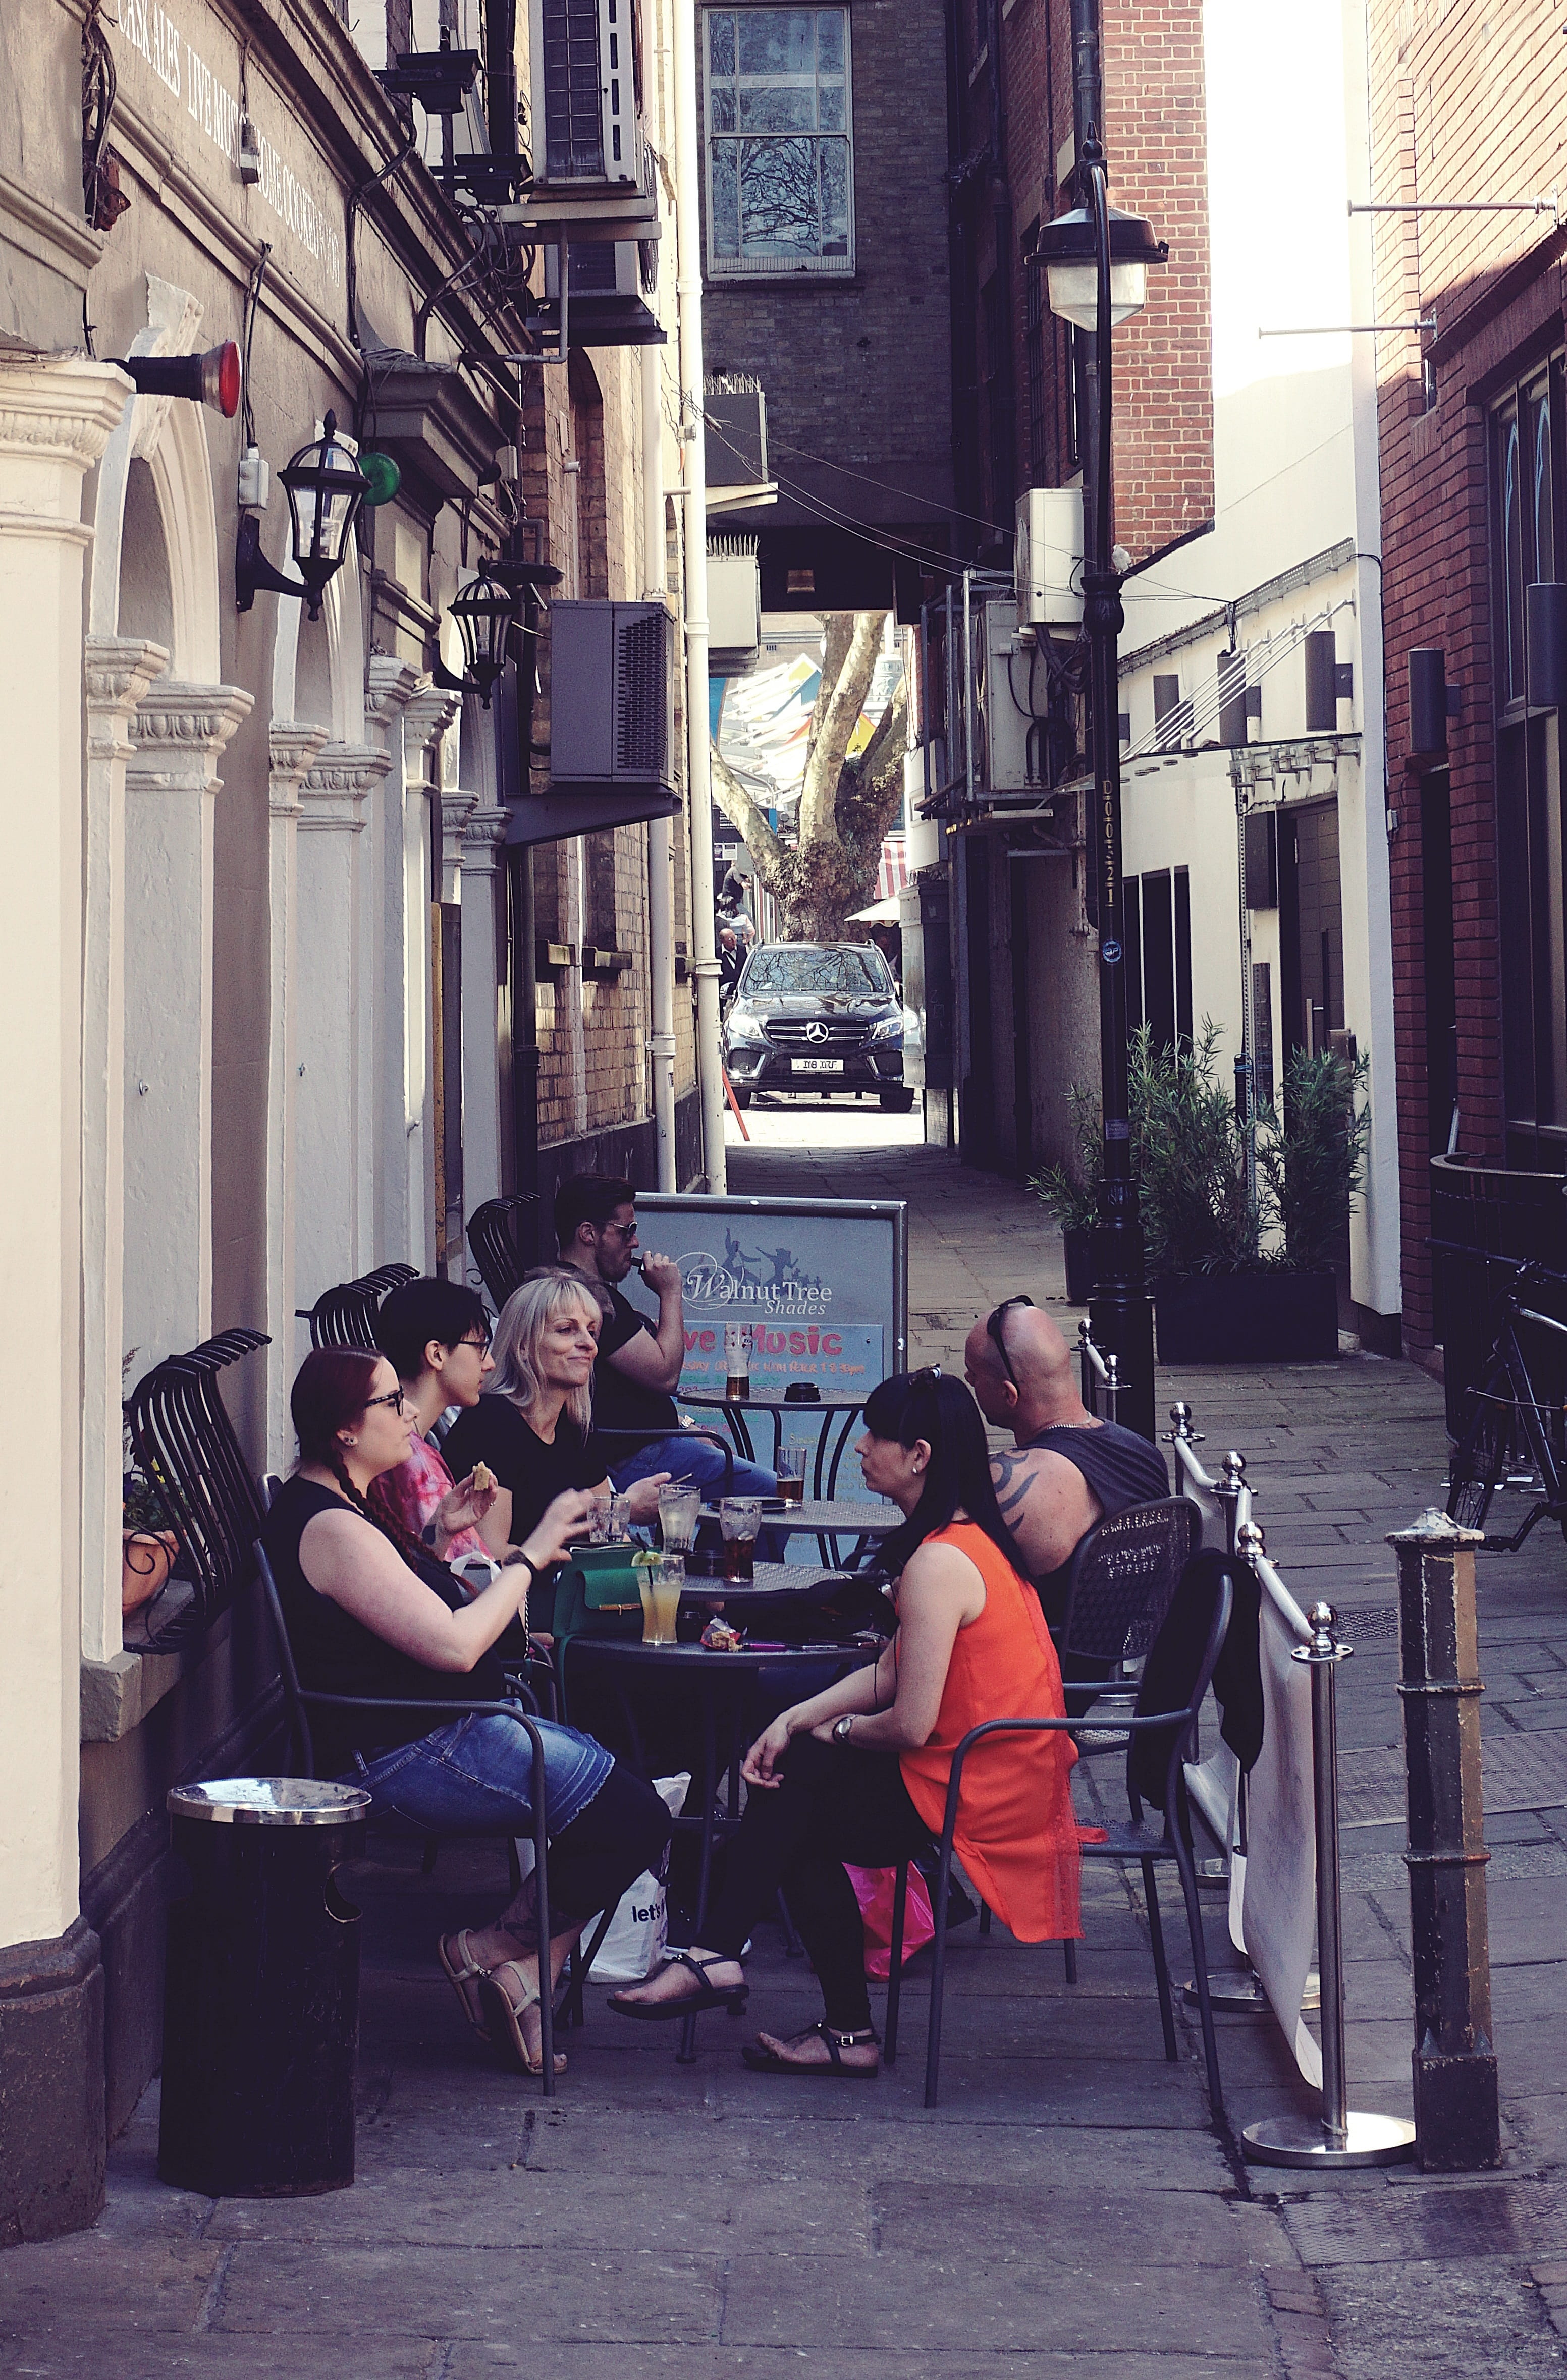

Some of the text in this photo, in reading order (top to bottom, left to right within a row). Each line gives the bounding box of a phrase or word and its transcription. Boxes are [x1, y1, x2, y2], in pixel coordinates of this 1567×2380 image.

[152, 2, 181, 98] ALES
[187, 45, 212, 137] LIVE
[283, 165, 319, 260] COOKED
[682, 1265, 832, 1304] Walnut Tree
[764, 1299, 826, 1315] Shades
[683, 1323, 842, 1356] ve Music
[632, 1903, 661, 1923] let's
